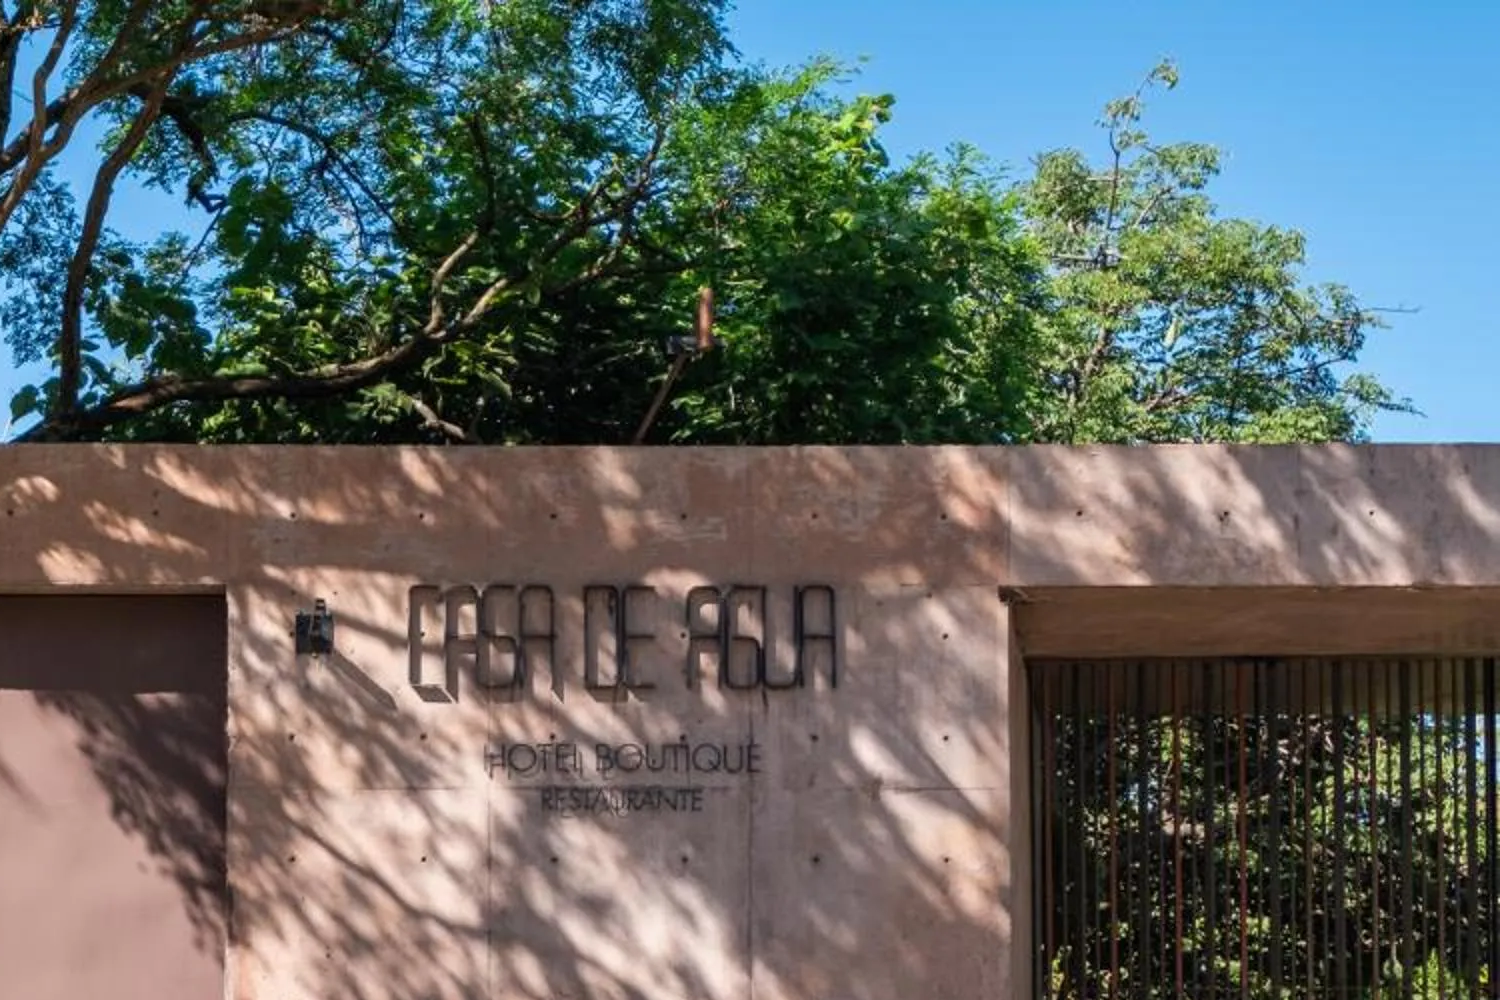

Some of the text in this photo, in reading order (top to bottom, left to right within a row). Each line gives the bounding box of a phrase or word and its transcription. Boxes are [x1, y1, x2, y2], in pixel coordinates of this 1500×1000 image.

[409, 585, 836, 691] CASA DE AGUA
[484, 743, 762, 774] HOTEL BOUTIQUE
[541, 787, 703, 813] RESTAURANTE
